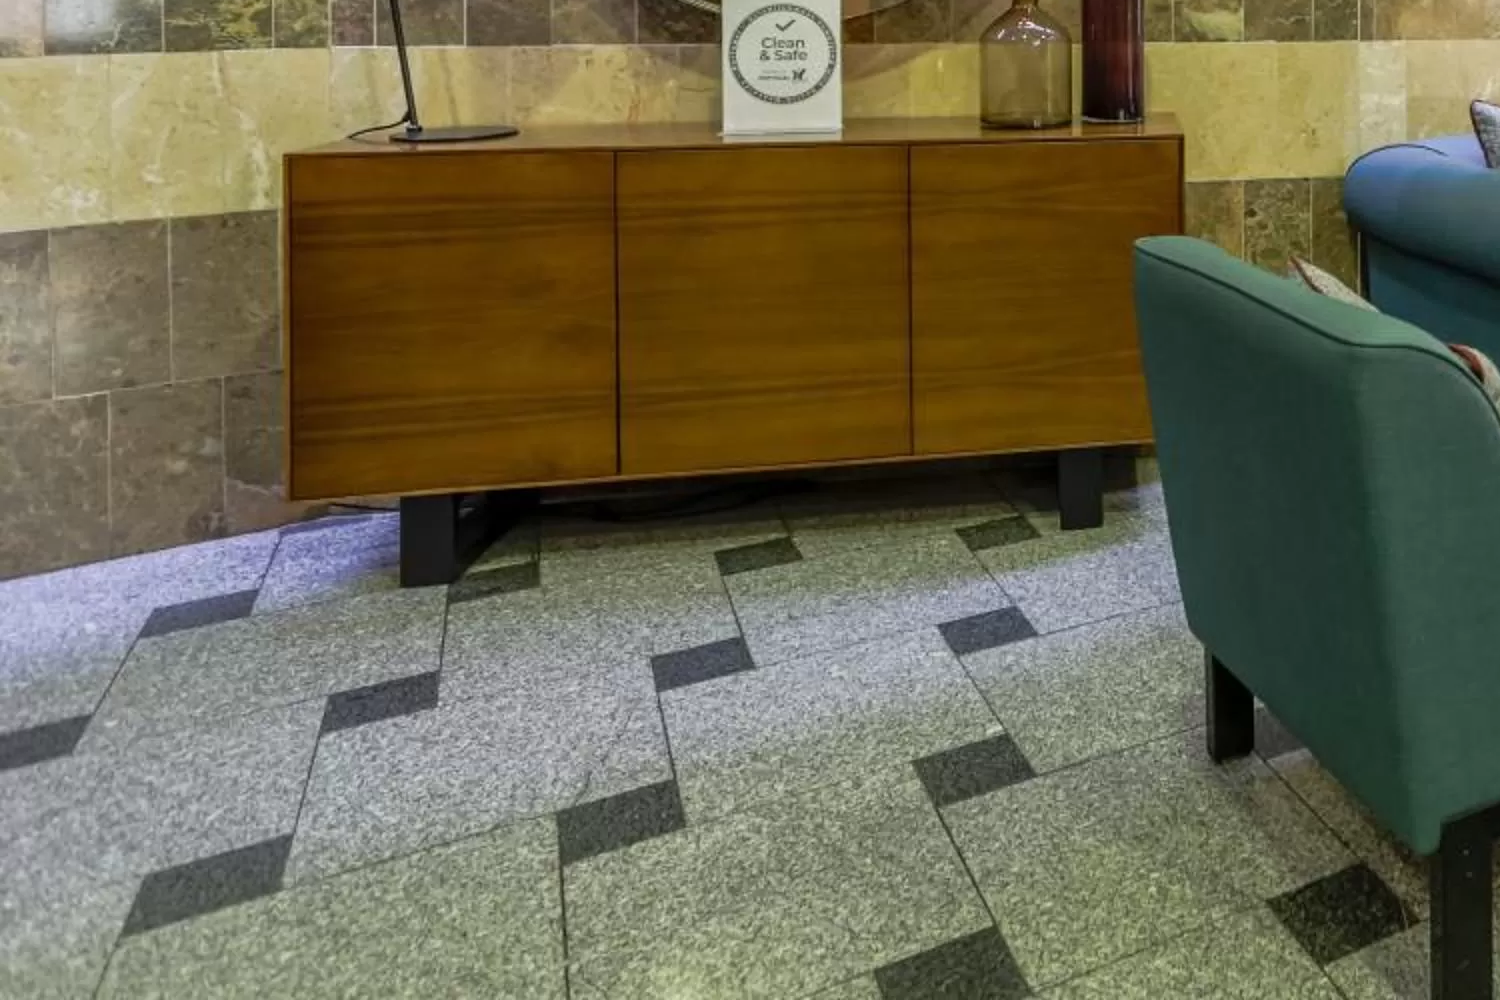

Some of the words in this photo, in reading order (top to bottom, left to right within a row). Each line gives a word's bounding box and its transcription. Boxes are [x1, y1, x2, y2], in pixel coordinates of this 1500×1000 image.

[761, 36, 805, 49] Clean
[759, 49, 771, 61] &
[774, 49, 808, 61] Safe
